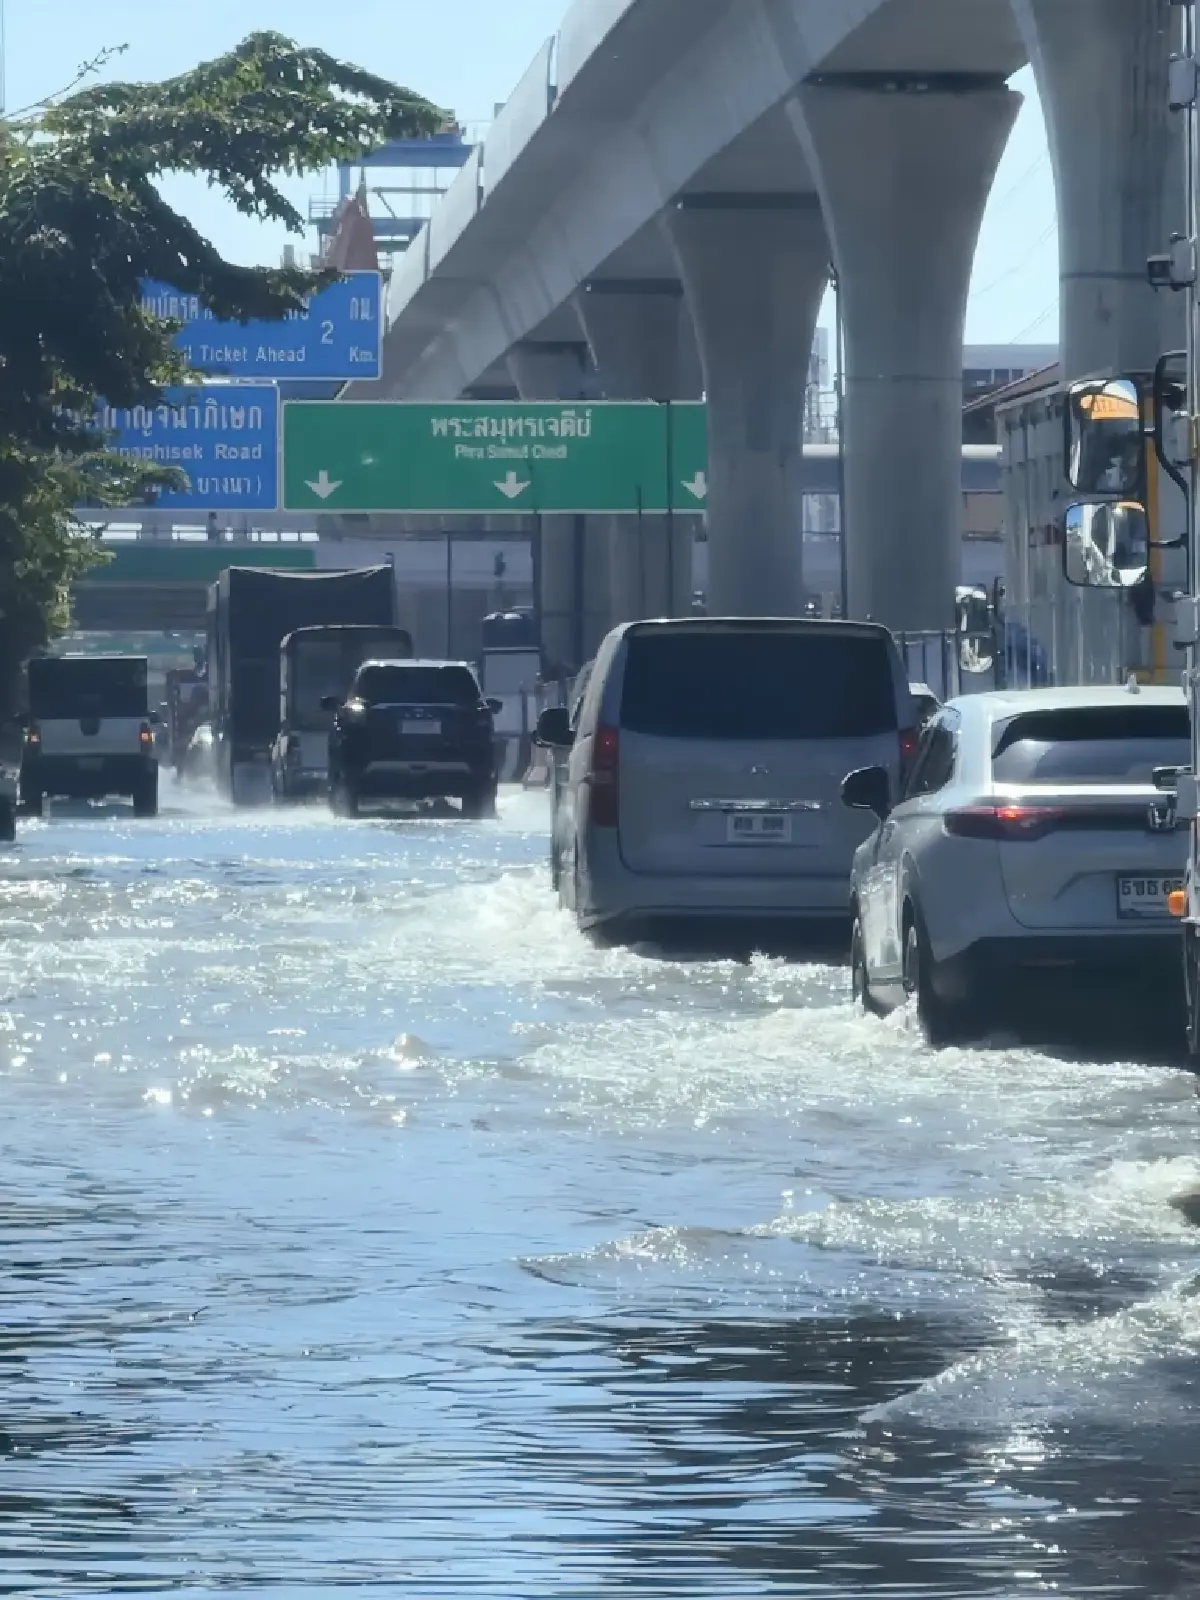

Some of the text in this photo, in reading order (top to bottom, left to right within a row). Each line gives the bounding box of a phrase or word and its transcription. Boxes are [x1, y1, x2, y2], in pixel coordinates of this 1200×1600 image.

[319, 319, 334, 345] 2
[200, 344, 248, 363] Ticket
[255, 344, 306, 363] Ahead
[214, 443, 262, 460] Road
